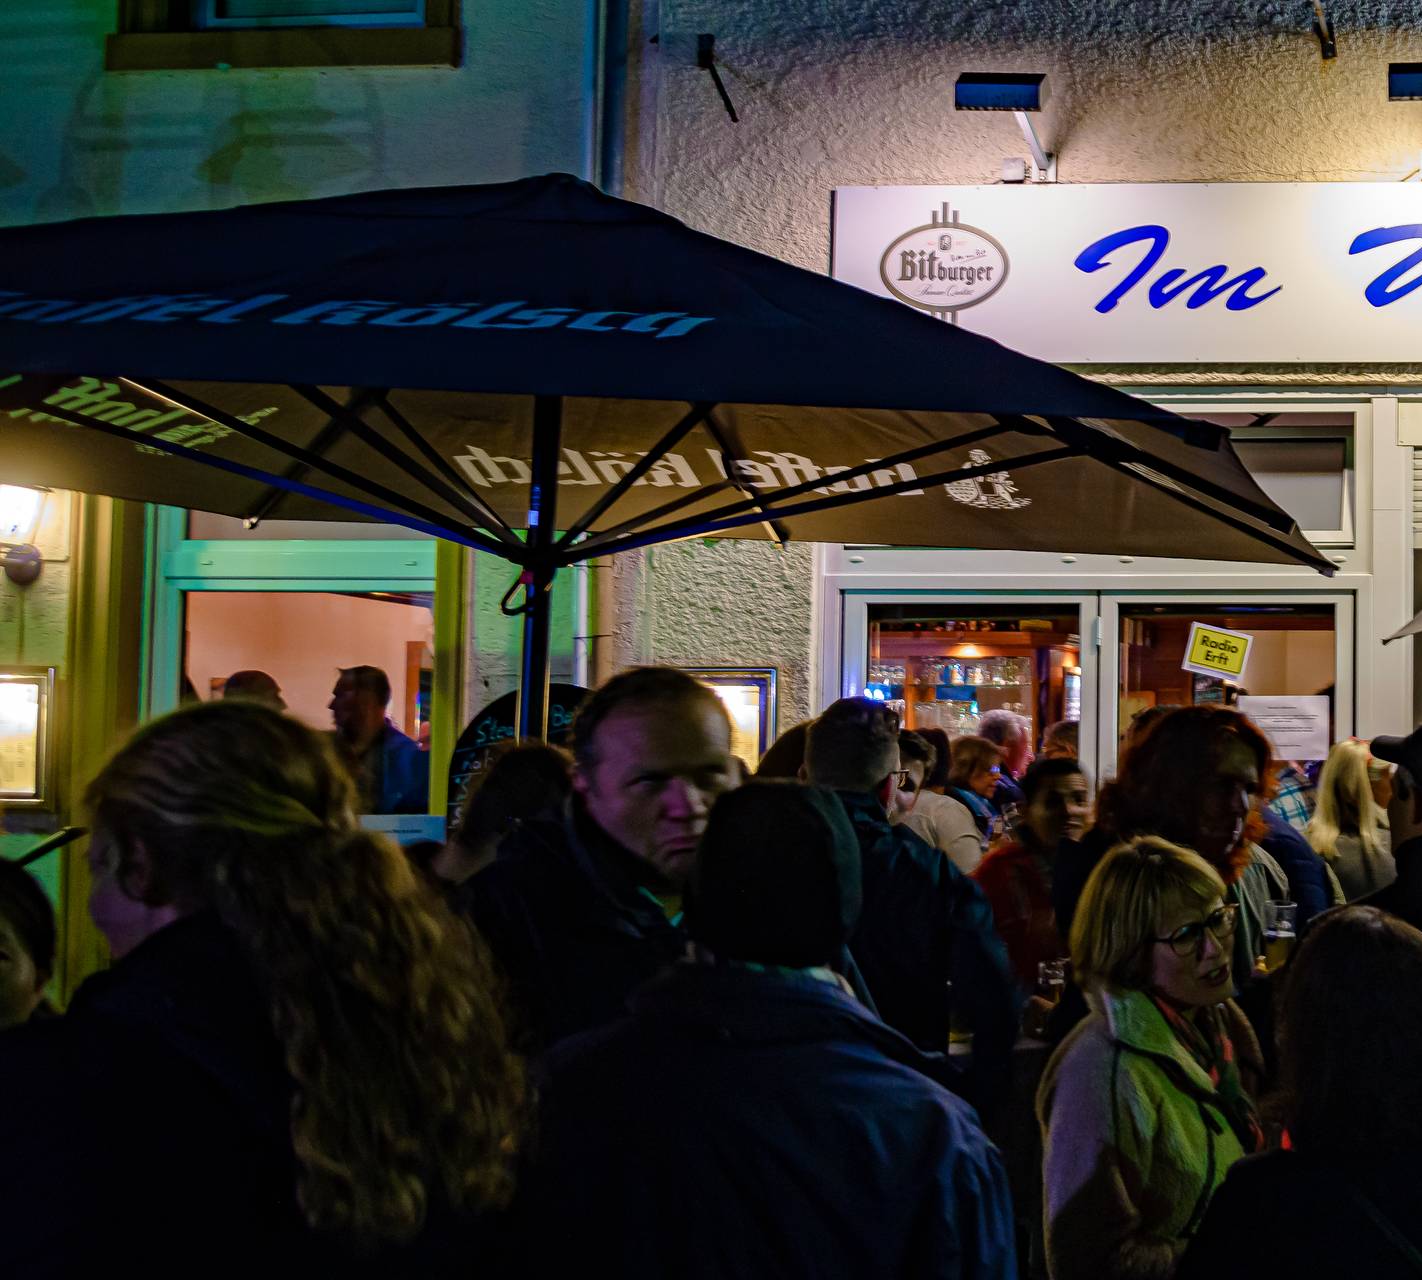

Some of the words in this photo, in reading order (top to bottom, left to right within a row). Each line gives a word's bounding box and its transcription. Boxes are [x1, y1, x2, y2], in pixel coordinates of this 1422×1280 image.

[898, 249, 994, 286] Bitburger
[1074, 224, 1283, 314] Im
[1200, 634, 1239, 654] Radio
[1205, 650, 1229, 665] Erft
